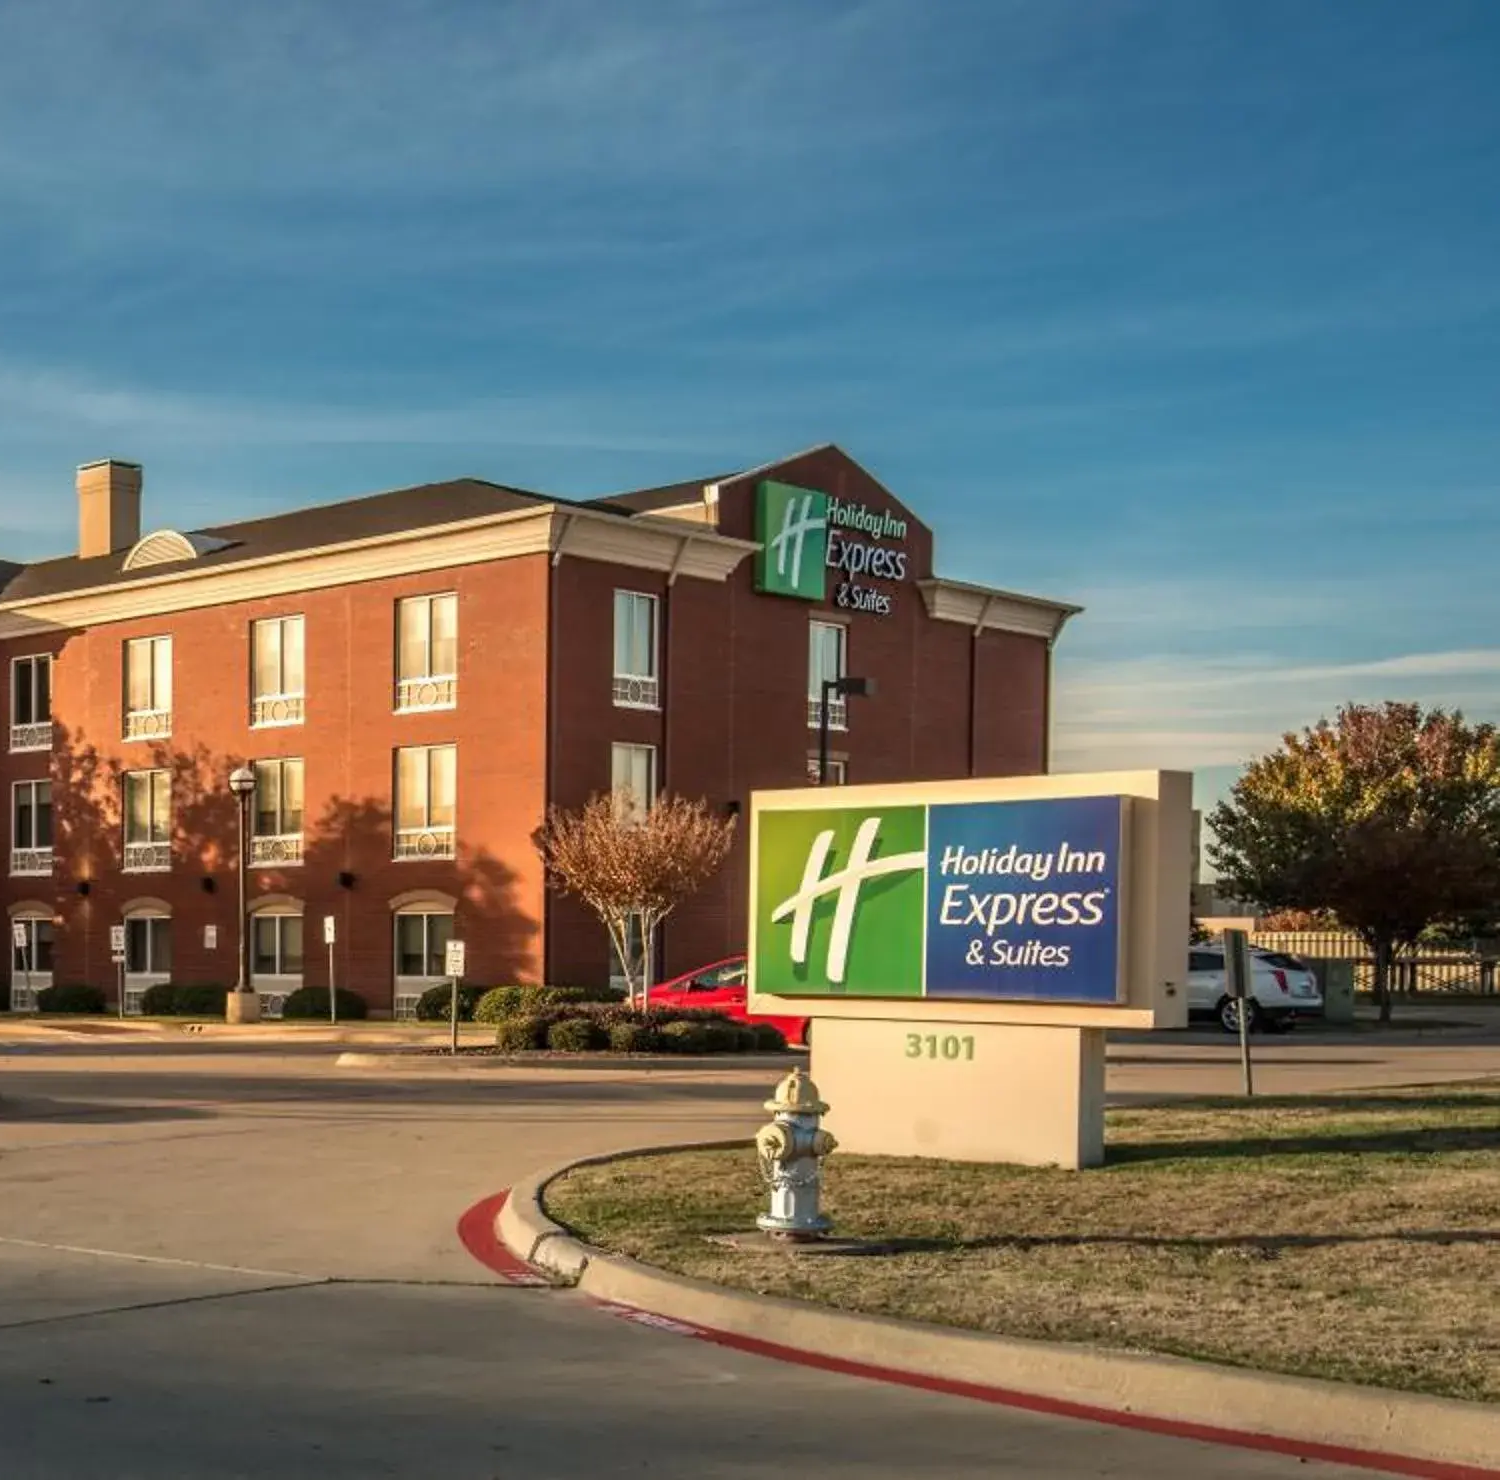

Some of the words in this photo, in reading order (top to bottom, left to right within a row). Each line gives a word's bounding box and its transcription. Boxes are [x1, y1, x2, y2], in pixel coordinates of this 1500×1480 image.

[826, 497, 884, 540] Holiday
[883, 508, 907, 538] Inn
[825, 529, 908, 581] Express
[837, 583, 849, 608] &
[850, 584, 892, 614] Suites
[939, 844, 1054, 881] Holiday
[1057, 841, 1106, 873] Inn
[939, 884, 1106, 937] Express
[965, 939, 985, 966] &
[989, 939, 1071, 967] Suites
[905, 1033, 975, 1061] 3101
